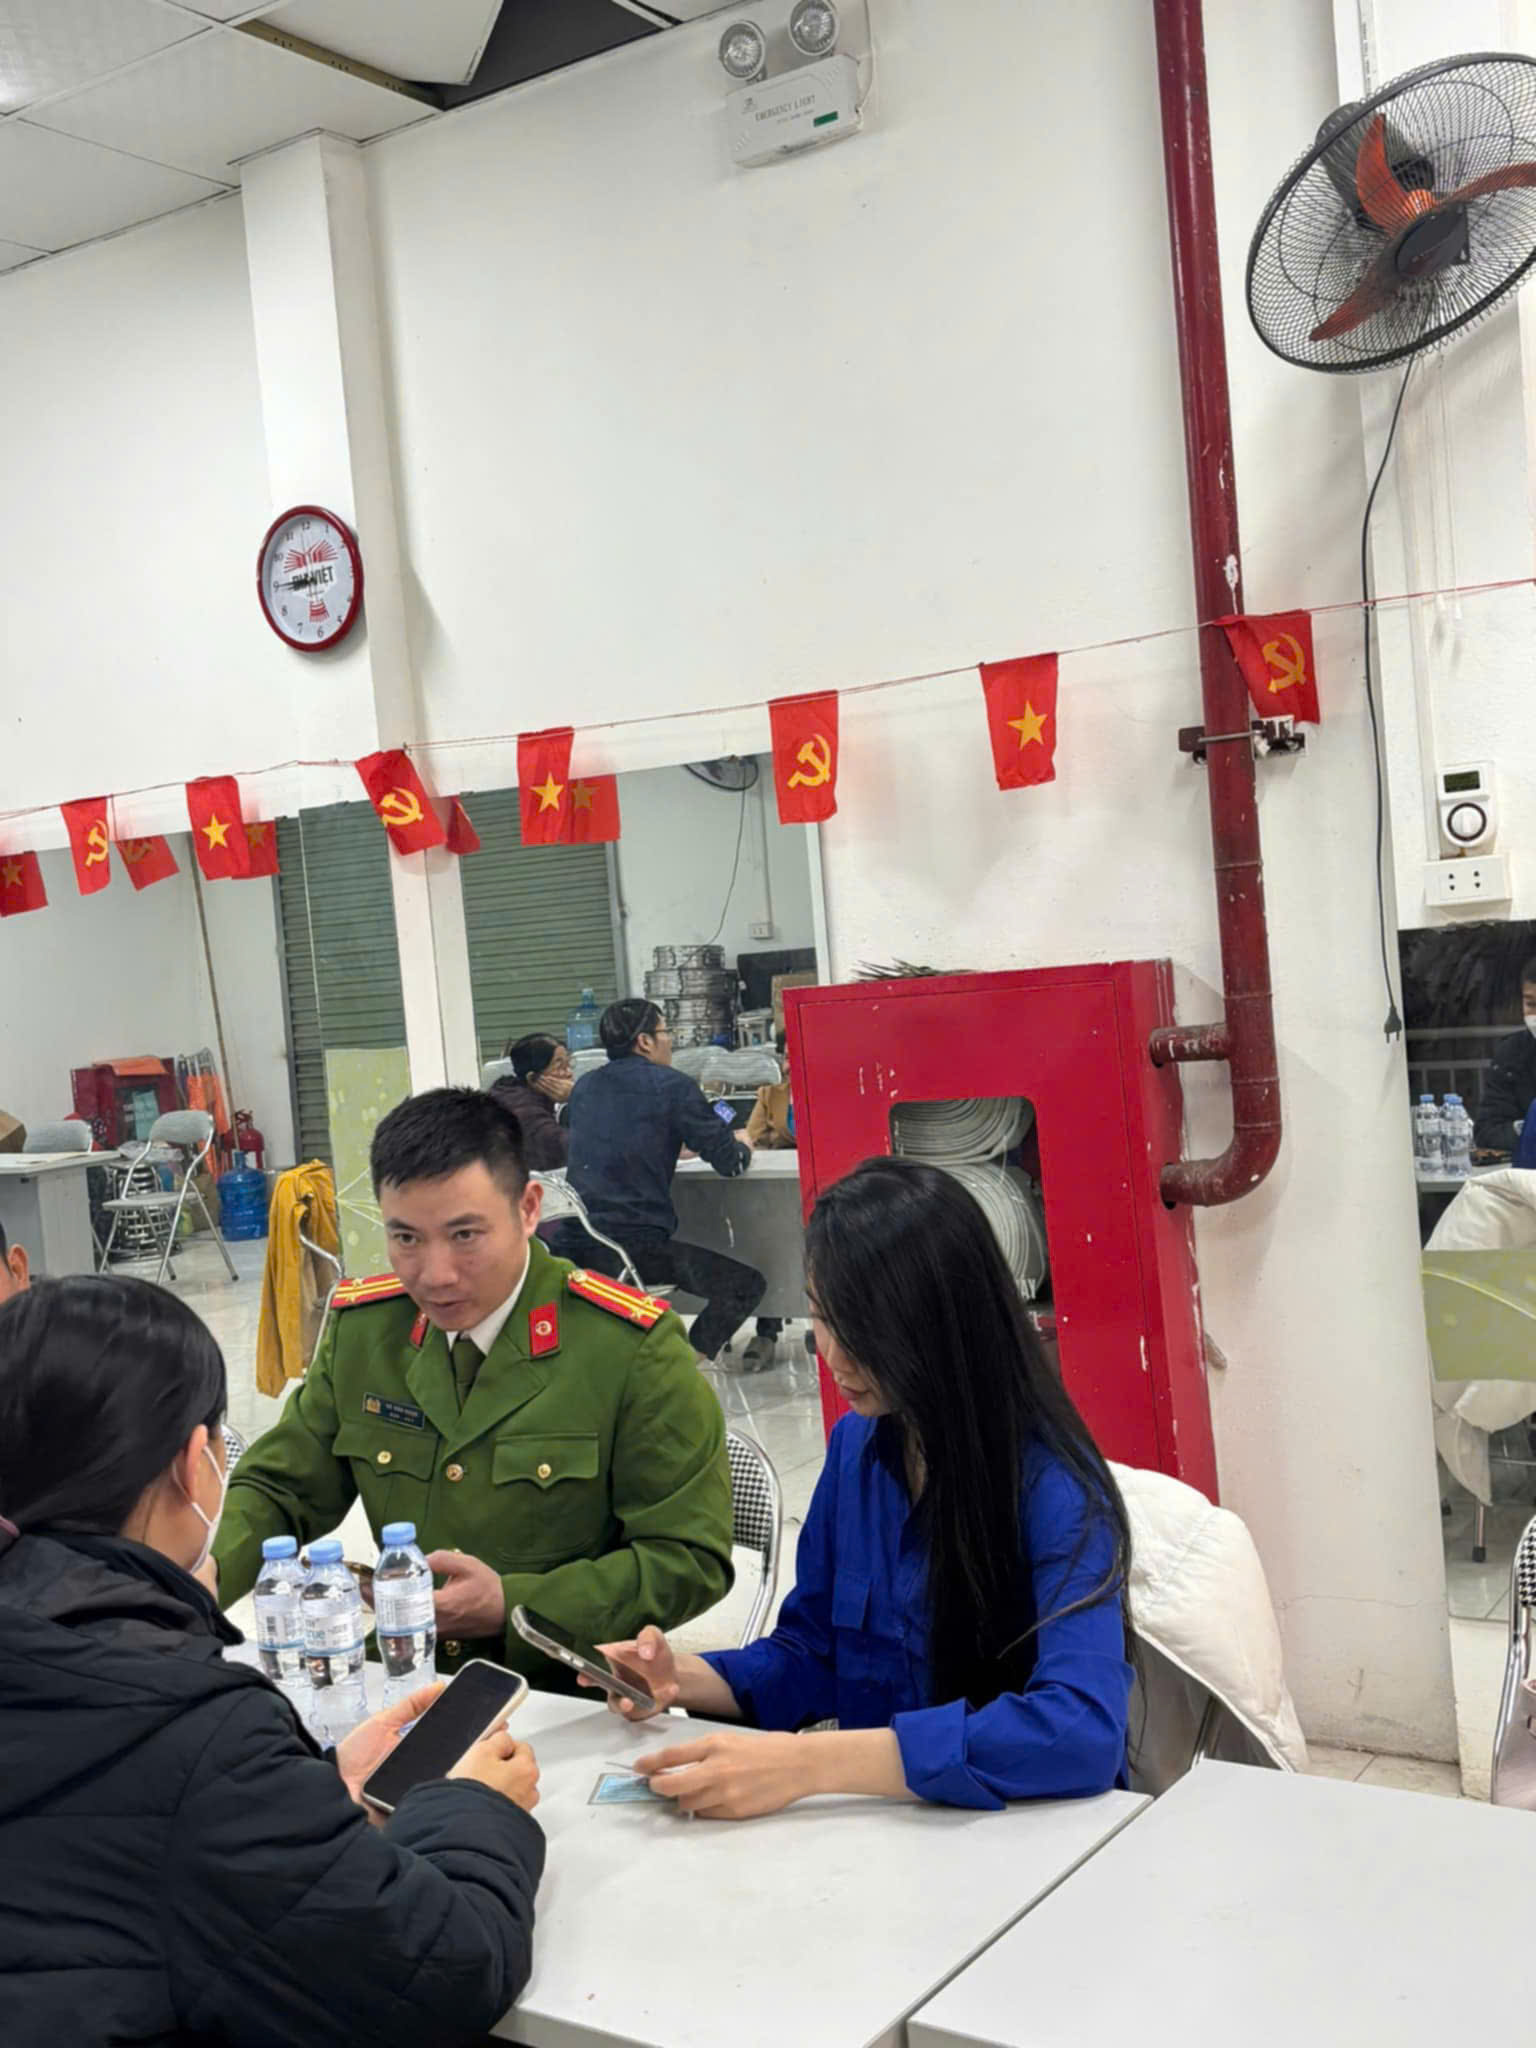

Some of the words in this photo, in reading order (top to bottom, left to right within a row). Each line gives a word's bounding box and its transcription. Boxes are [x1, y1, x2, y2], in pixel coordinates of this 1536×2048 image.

[301, 521, 311, 531] 12
[281, 606, 288, 616] 8
[296, 622, 303, 634] 7
[317, 626, 324, 638] 6
